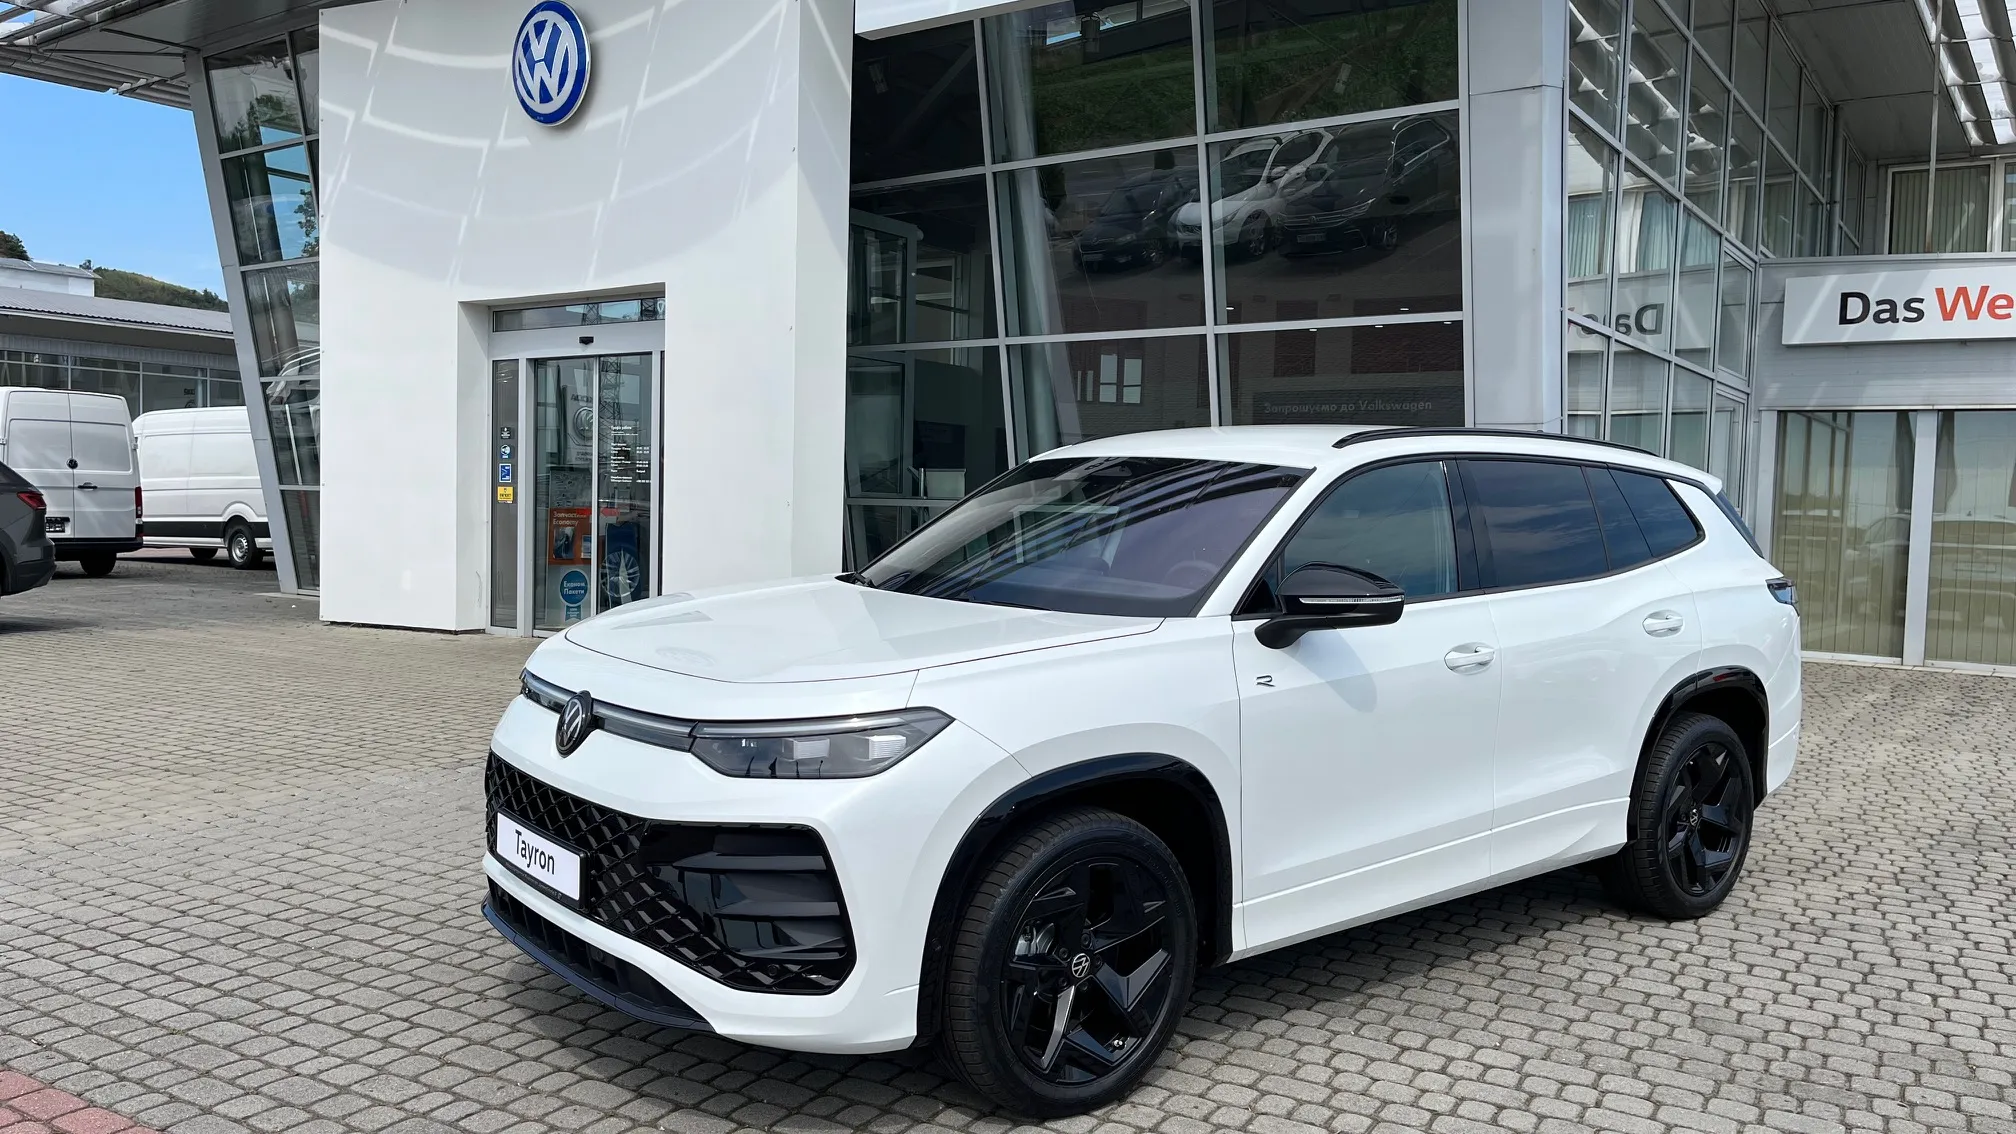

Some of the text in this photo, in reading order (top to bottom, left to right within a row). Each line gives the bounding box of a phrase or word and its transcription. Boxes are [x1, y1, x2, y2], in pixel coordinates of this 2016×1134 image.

[1838, 285, 2014, 325] Das We
[1264, 403, 1338, 416] Запрошуємо
[1340, 404, 1355, 413] до
[1256, 675, 1275, 687] R
[515, 829, 555, 875] Tayron
